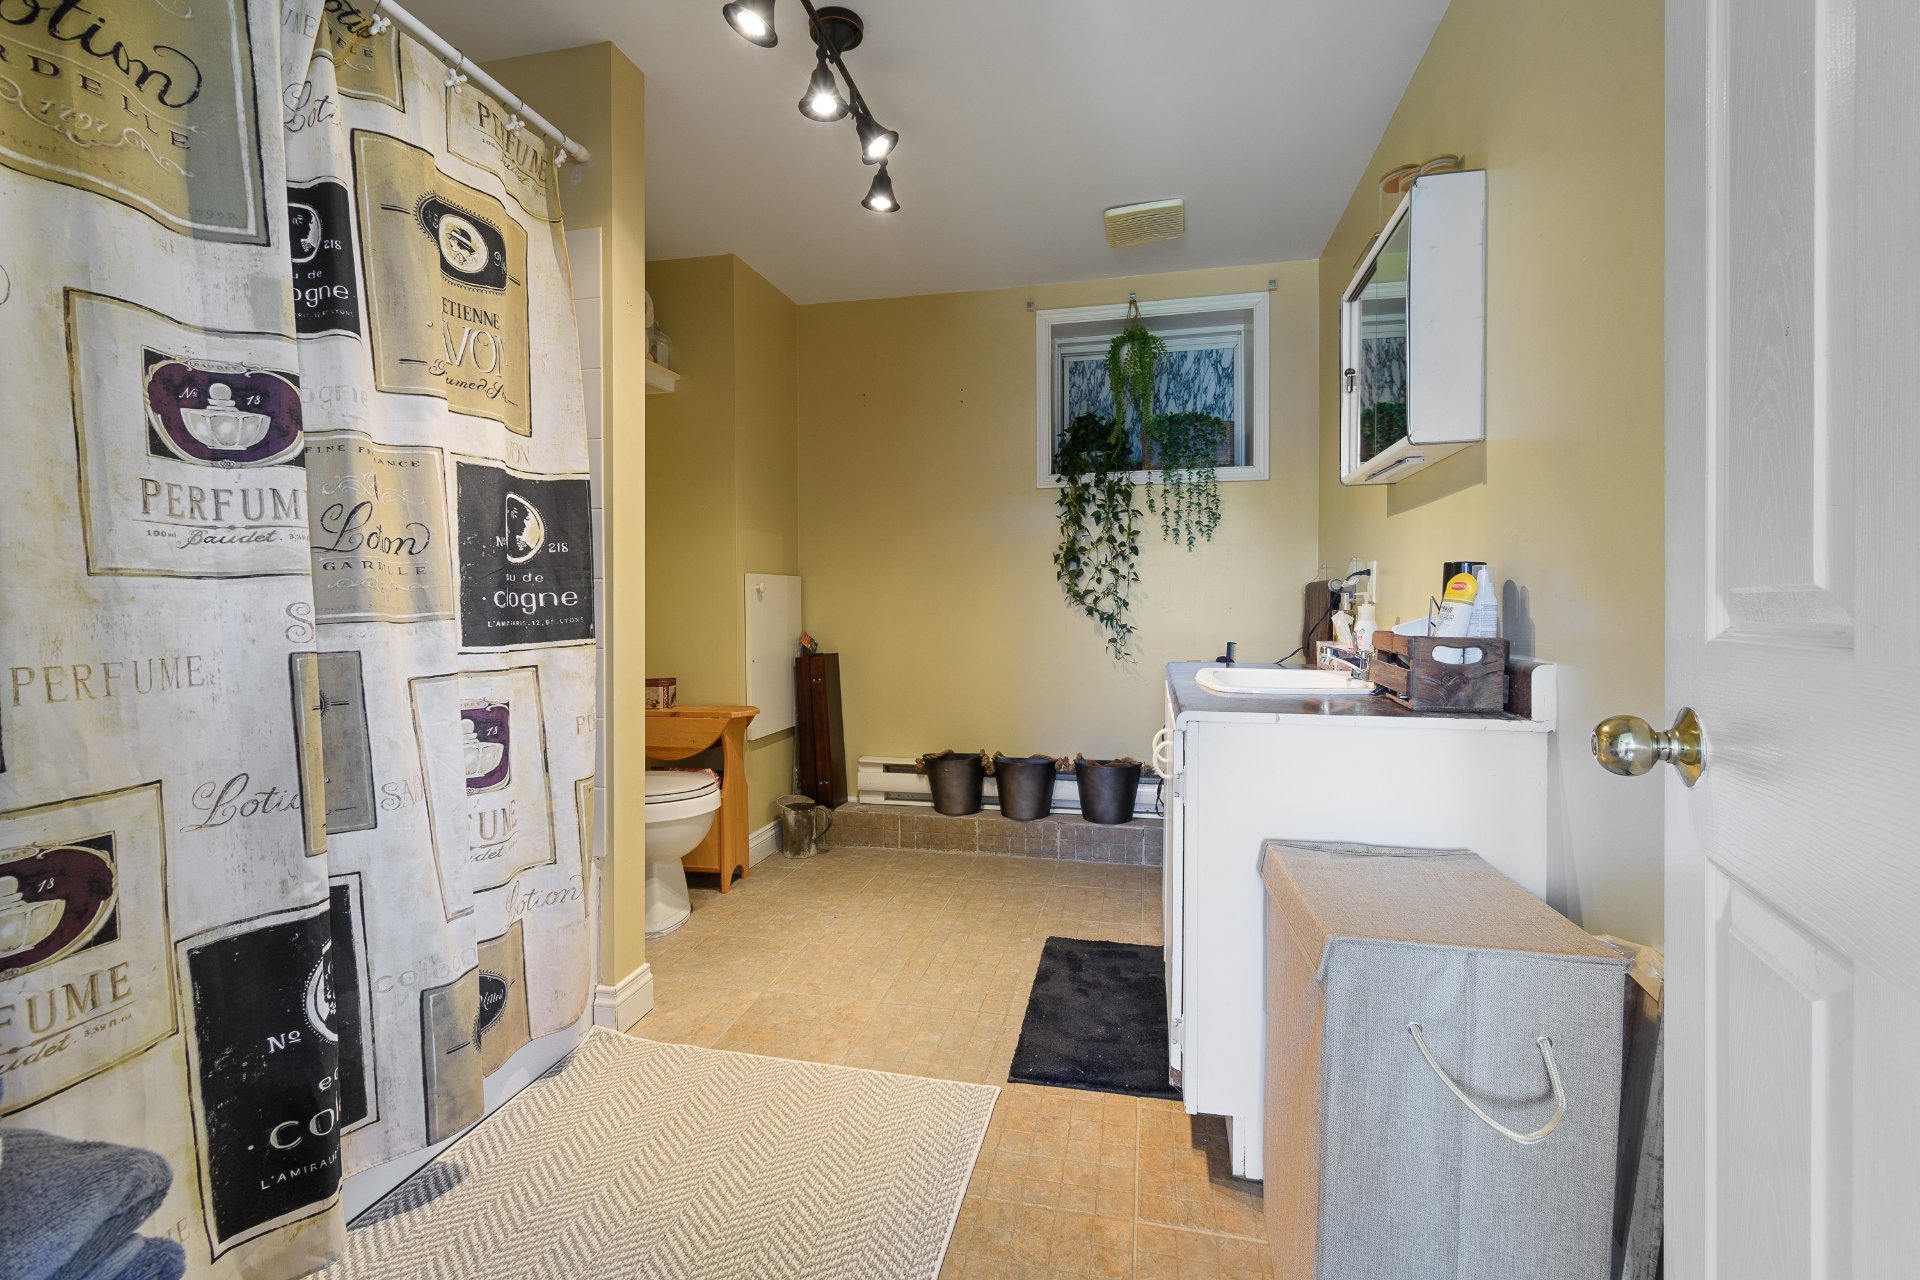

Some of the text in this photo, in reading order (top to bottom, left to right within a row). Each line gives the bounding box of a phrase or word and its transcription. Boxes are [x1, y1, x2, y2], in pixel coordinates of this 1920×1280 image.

[323, 239, 342, 250] 218
[307, 269, 322, 280] de
[442, 296, 500, 330] ETIENNE
[246, 395, 261, 406] 18
[304, 444, 346, 454] FINE
[139, 477, 309, 523] PERFUM
[177, 529, 277, 550] Baudet
[548, 542, 569, 553] 218
[522, 571, 544, 582] de
[9, 655, 206, 706] PERFUME
[486, 725, 499, 737] 18
[37, 877, 56, 893] 18
